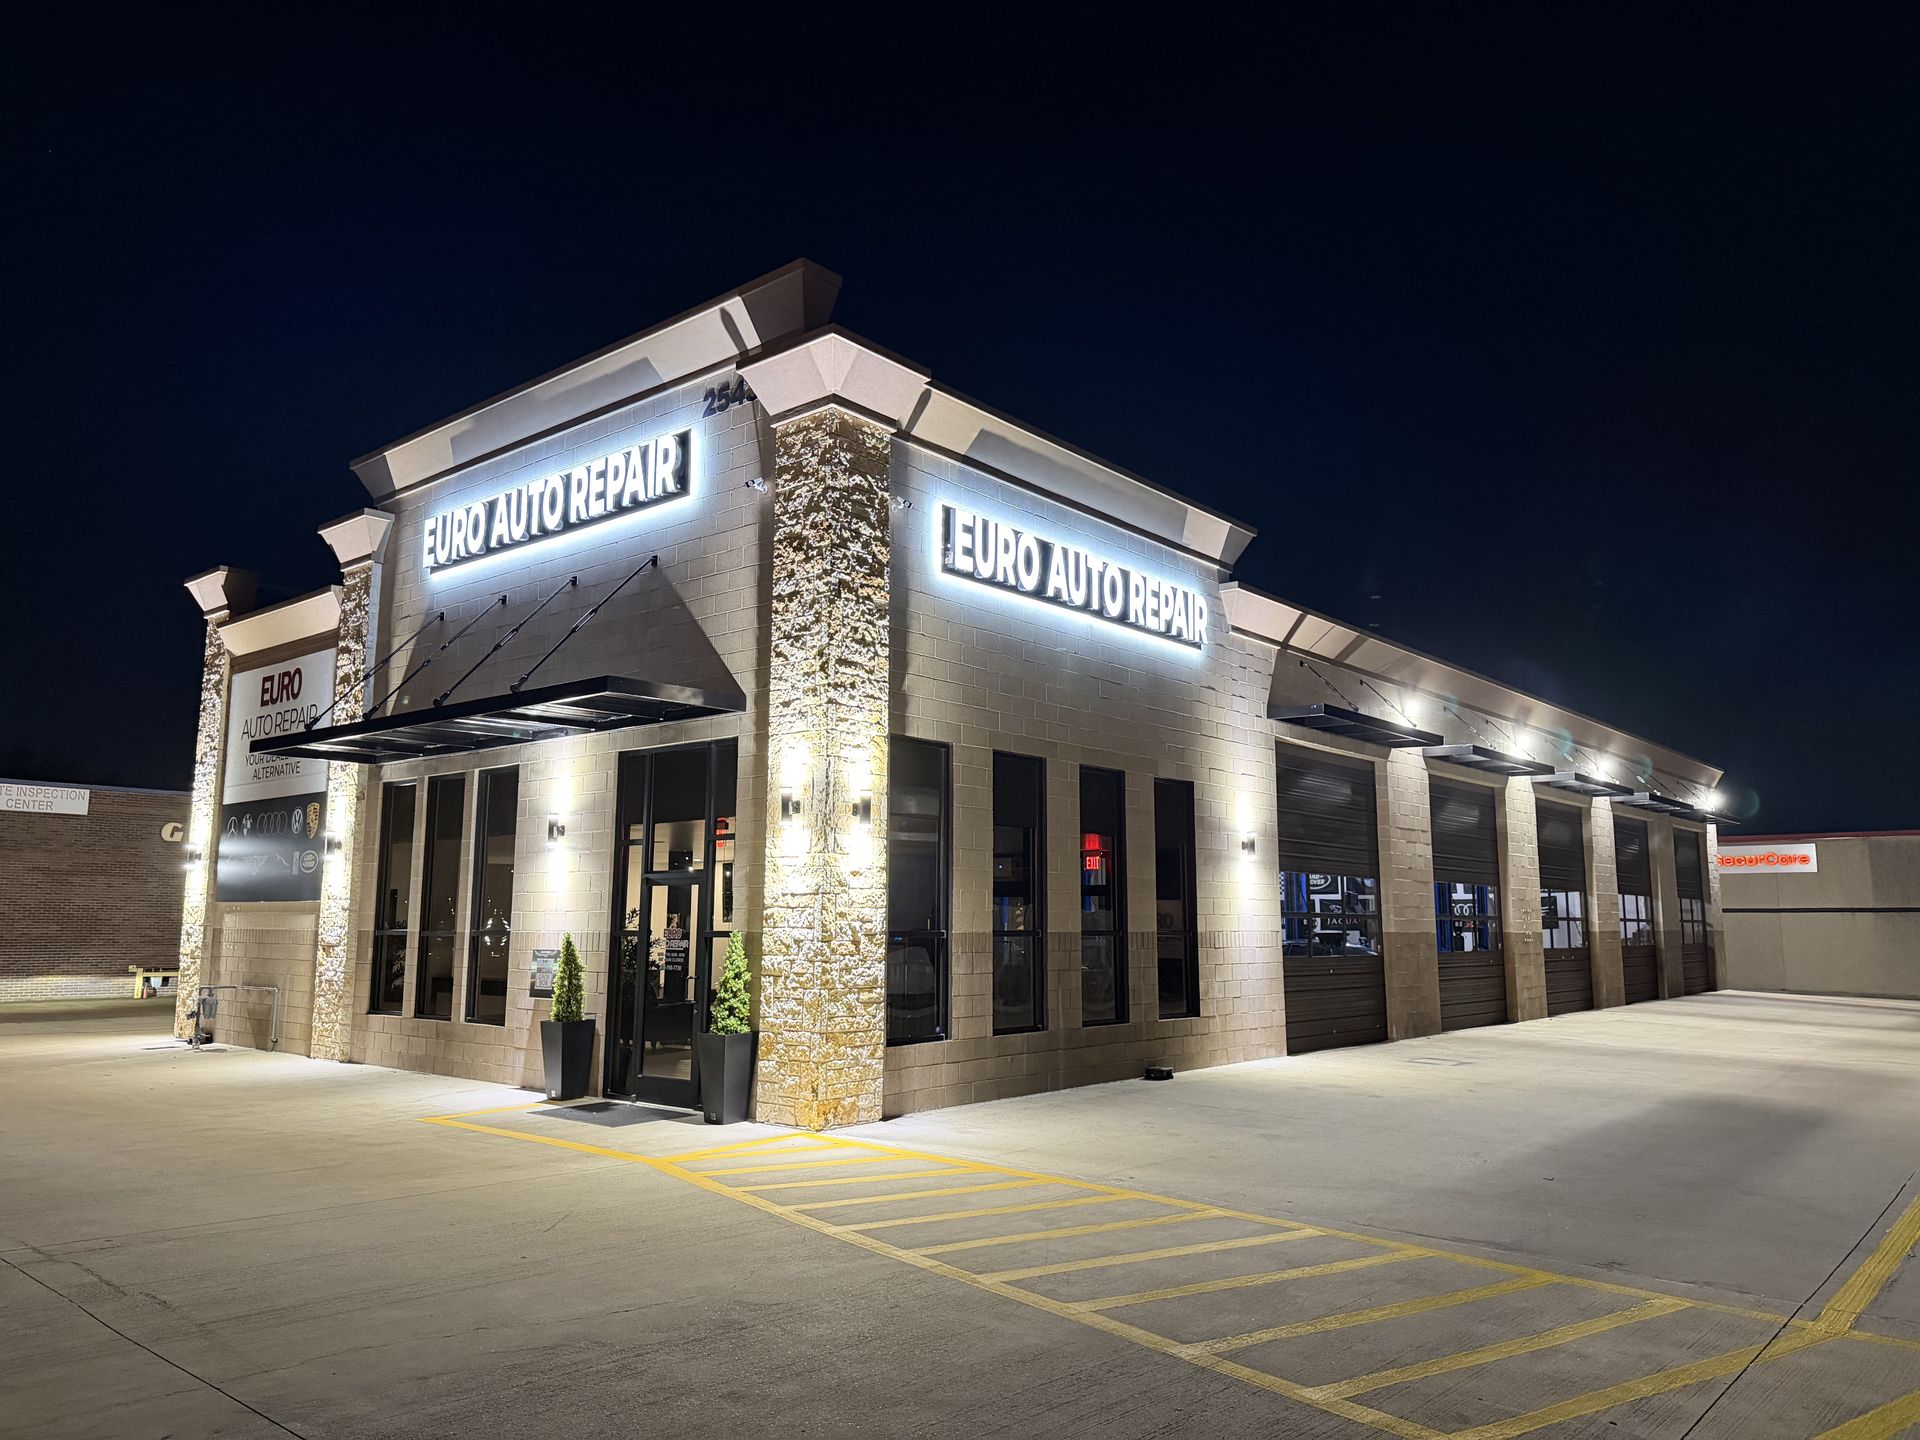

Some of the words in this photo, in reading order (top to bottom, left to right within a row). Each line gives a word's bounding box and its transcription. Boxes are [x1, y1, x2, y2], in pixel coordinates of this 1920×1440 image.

[423, 502, 485, 568] EURO
[489, 475, 565, 548] AUTO
[570, 435, 677, 523] REPAIR
[955, 508, 1040, 591] EURO
[1048, 543, 1123, 617] AUTO
[1129, 570, 1208, 643] REPAIR
[260, 667, 303, 707] EURO
[241, 714, 273, 740] AUTO
[245, 754, 265, 766] YOUR
[252, 761, 301, 780] ALTERNATIVE
[17, 786, 86, 800] INSPECTION
[6, 798, 54, 811] CENTER
[1086, 856, 1100, 870] EXIT
